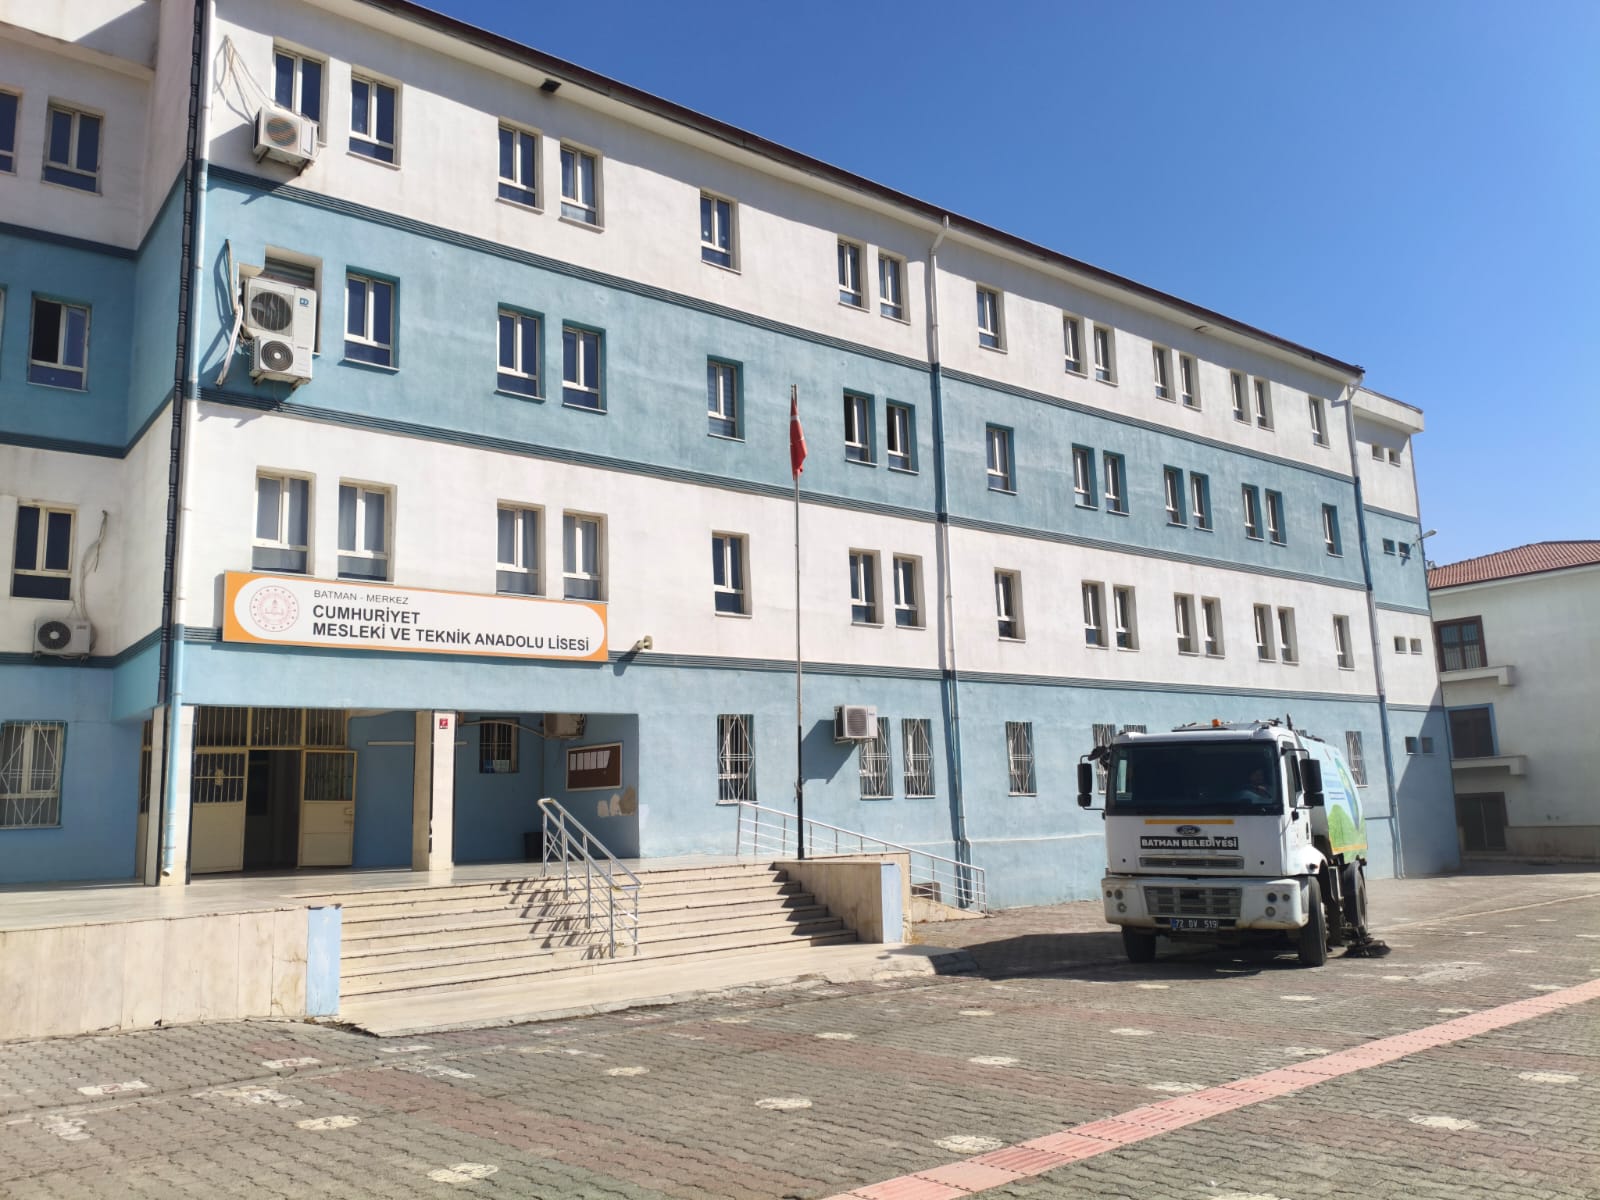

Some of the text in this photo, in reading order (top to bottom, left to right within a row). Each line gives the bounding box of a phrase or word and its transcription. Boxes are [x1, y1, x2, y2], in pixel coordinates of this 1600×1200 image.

[314, 589, 357, 601] BATMAN
[366, 593, 409, 605] MERKEZ
[312, 604, 420, 625] CUMHURİYET
[312, 622, 589, 651] MESLEKİ VE TEKNİK ANADOLU LİSESİ
[1141, 836, 1237, 848] BATMAN BELEDİYESİ
